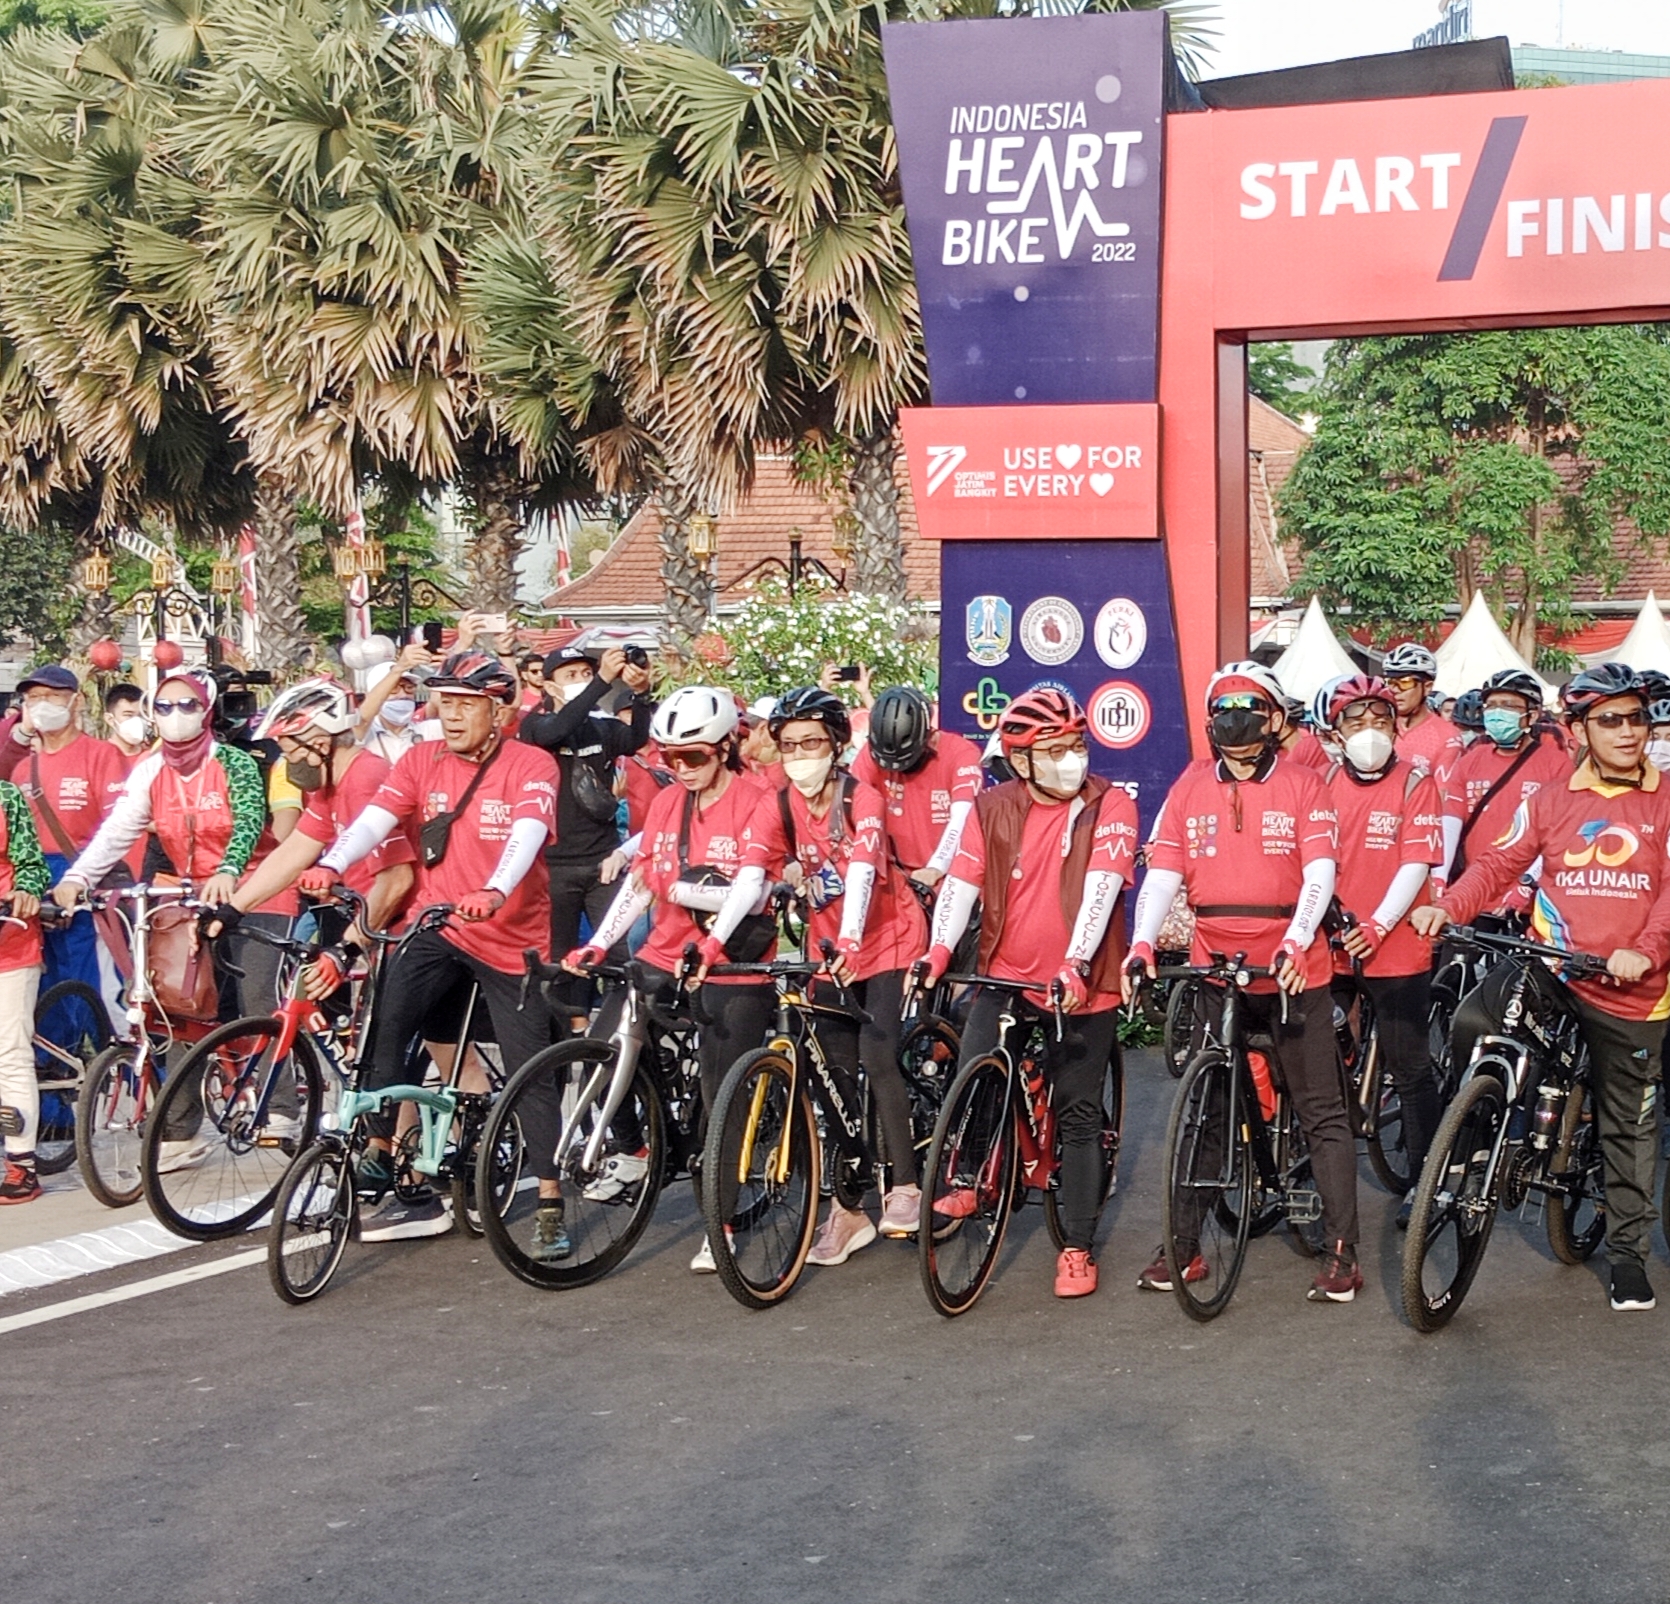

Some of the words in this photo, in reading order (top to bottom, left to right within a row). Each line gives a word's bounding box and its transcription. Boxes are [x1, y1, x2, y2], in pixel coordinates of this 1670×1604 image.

[949, 101, 1087, 133] INDONESIA
[944, 131, 1143, 196] HEART
[1239, 152, 1461, 220] START
[941, 217, 1049, 266] BIKE
[1091, 242, 1135, 263] 2022
[1003, 447, 1053, 470] USE
[1087, 446, 1142, 469] FOR
[1003, 474, 1085, 497] EVERY
[1589, 869, 1652, 891] UNAIR
